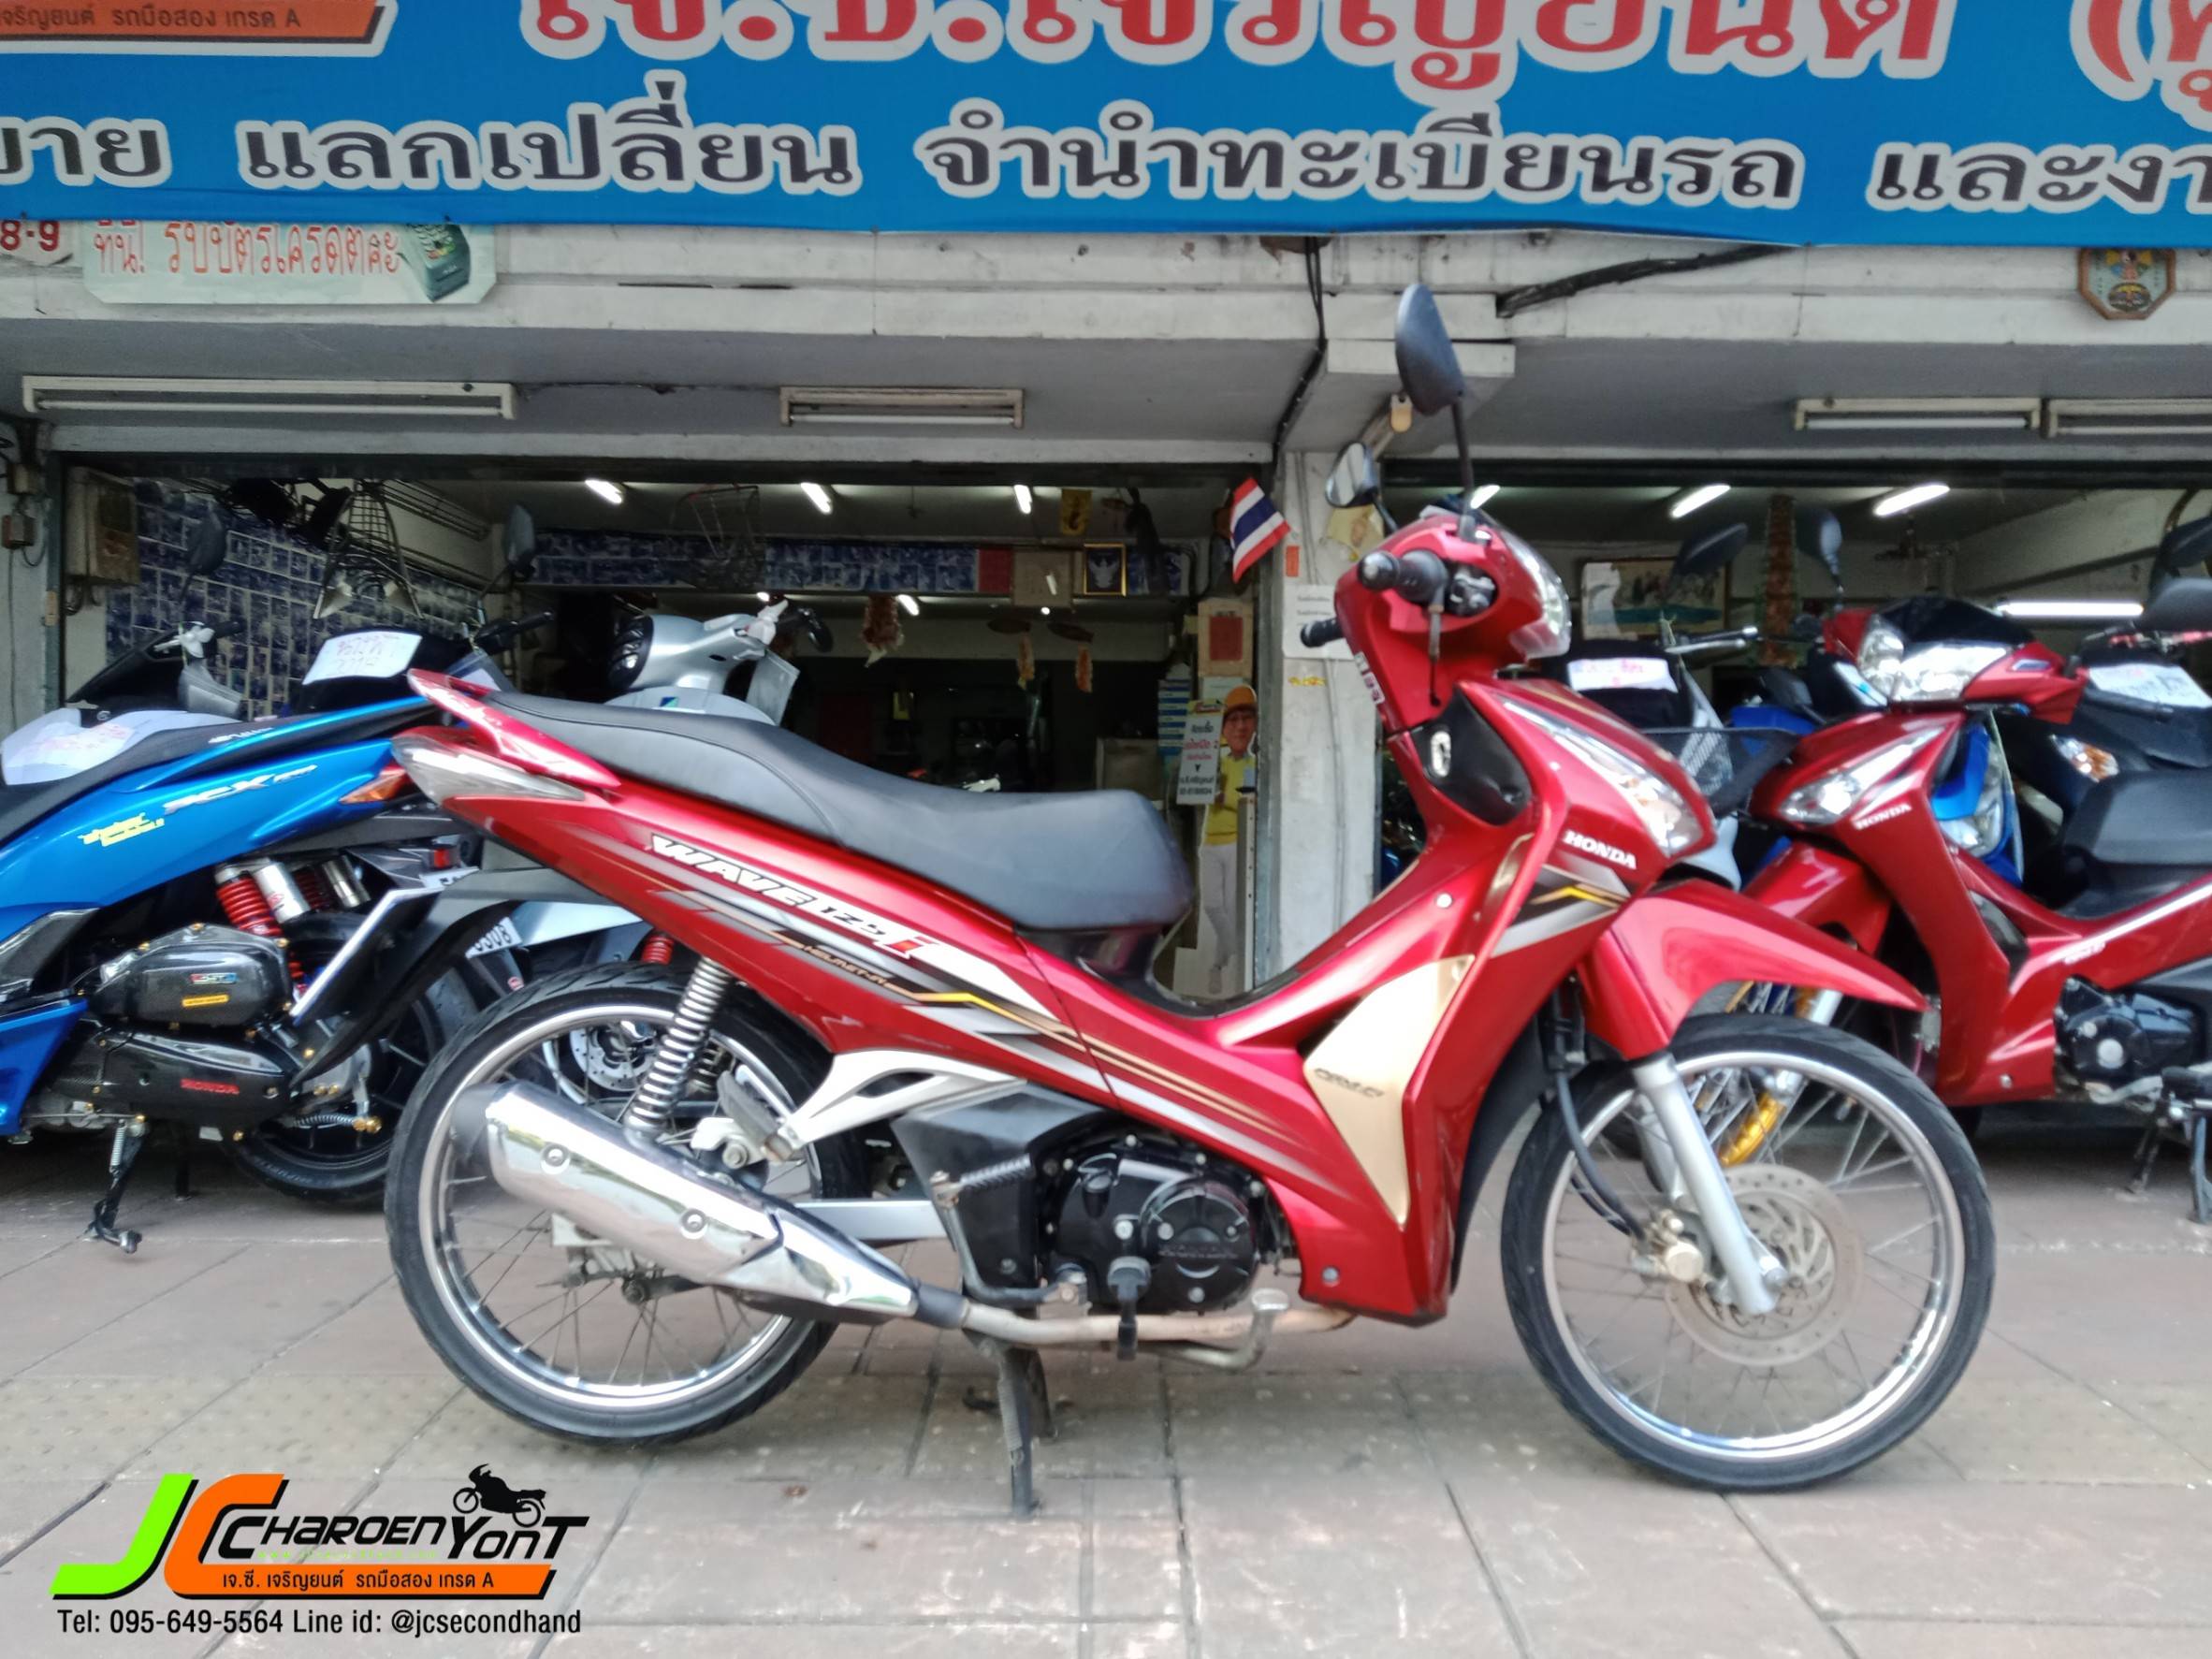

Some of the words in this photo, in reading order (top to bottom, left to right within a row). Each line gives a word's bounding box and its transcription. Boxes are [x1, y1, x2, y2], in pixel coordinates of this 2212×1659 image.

[0, 4, 95, 31] จริญยนต์
[285, 10, 300, 27] A
[246, 80, 853, 184] แลกเปลี่ยน
[925, 109, 1795, 198] จำนำทะเบียนรถ
[1563, 829, 1637, 870] HONDA
